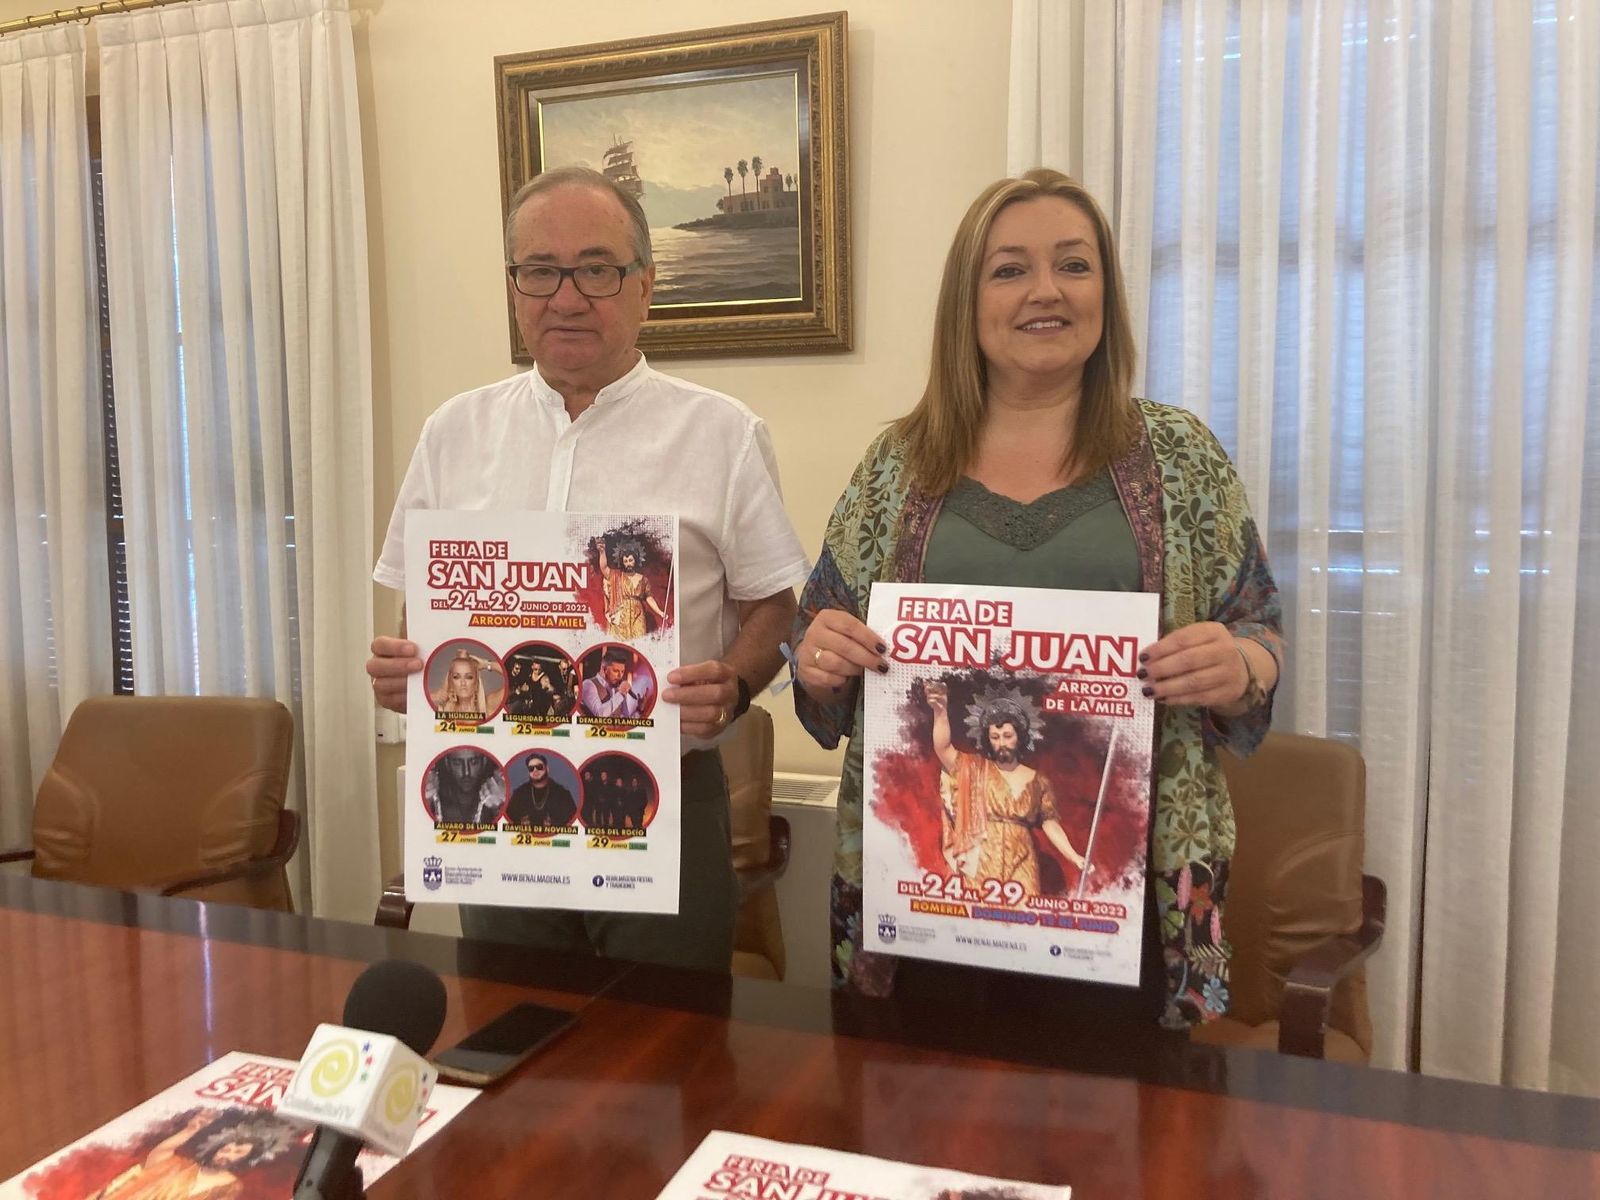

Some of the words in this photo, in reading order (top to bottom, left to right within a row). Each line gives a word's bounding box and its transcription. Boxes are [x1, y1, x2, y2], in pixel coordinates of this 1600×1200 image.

[431, 542, 480, 558] FERIA
[484, 542, 507, 559] DE
[430, 561, 494, 588] SAN
[503, 563, 588, 590] JUAN
[432, 600, 447, 609] DEL
[449, 591, 477, 610] 24
[478, 601, 488, 609] AL
[490, 592, 518, 610] 29
[522, 602, 550, 611] JUNIO
[552, 603, 562, 611] DE
[565, 603, 587, 612] 2022
[899, 599, 970, 622] FERIA
[977, 603, 1010, 625] DE
[471, 616, 519, 626] ARROYO
[523, 617, 536, 626] DE
[540, 617, 554, 627] LA
[558, 617, 584, 628] MIEL
[894, 626, 988, 665] SAN
[1003, 633, 1134, 675] JUAN
[1058, 681, 1126, 697] ARROYO
[1045, 698, 1065, 711] DE
[1070, 700, 1090, 712] LA
[1095, 701, 1133, 716] MIEL
[505, 714, 544, 722] SEGURIDAD
[545, 715, 570, 723] SOCIAL
[580, 717, 613, 725] DEMARCO
[614, 718, 652, 726] FLAMENCO
[440, 721, 456, 732] 24
[516, 724, 532, 734] 25
[591, 726, 607, 737] 26
[544, 826, 577, 834] NOVELDA
[587, 827, 606, 835] ECOS
[607, 828, 620, 836] DEL
[441, 831, 458, 842] 27
[516, 834, 532, 845] 28
[591, 837, 609, 848] 29
[899, 882, 921, 895] DEL
[922, 874, 964, 900] 24
[964, 889, 979, 901] AL
[982, 879, 1024, 906] 29
[1028, 897, 1069, 911] JUNIO
[1072, 901, 1089, 913] DE
[1092, 903, 1126, 917] 2022
[723, 1155, 790, 1180] FERIA
[793, 1168, 829, 1185] DE
[705, 1170, 801, 1200] SAN
